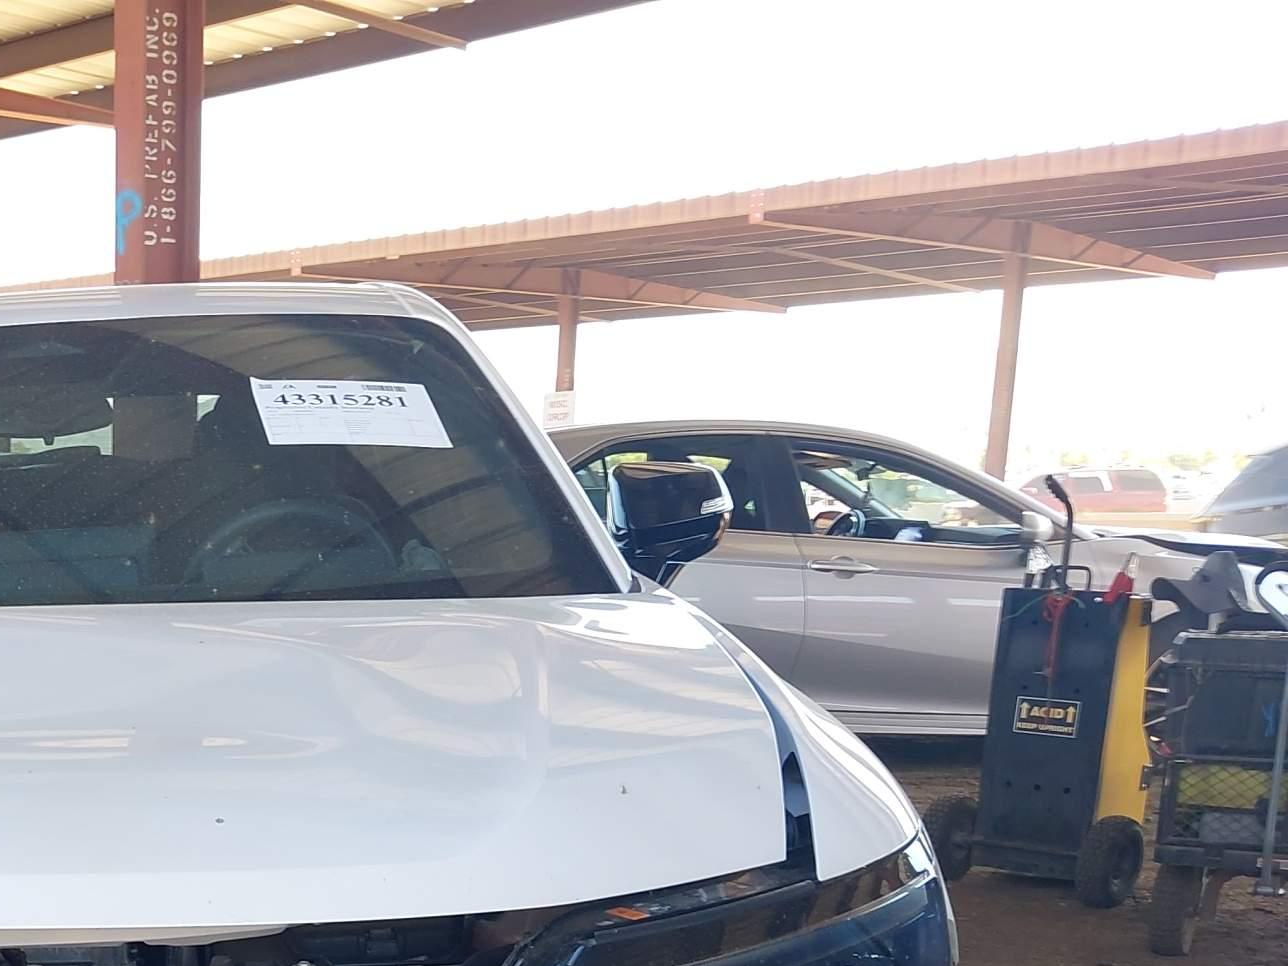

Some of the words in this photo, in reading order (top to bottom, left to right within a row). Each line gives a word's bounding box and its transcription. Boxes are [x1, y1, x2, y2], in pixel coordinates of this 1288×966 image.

[145, 8, 160, 58] INC.
[144, 74, 159, 178] PREFAB
[160, 12, 178, 243] 1-866-799-0969
[144, 196, 158, 246] U.S.
[273, 393, 408, 408] 43315281
[1030, 705, 1065, 719] ACID
